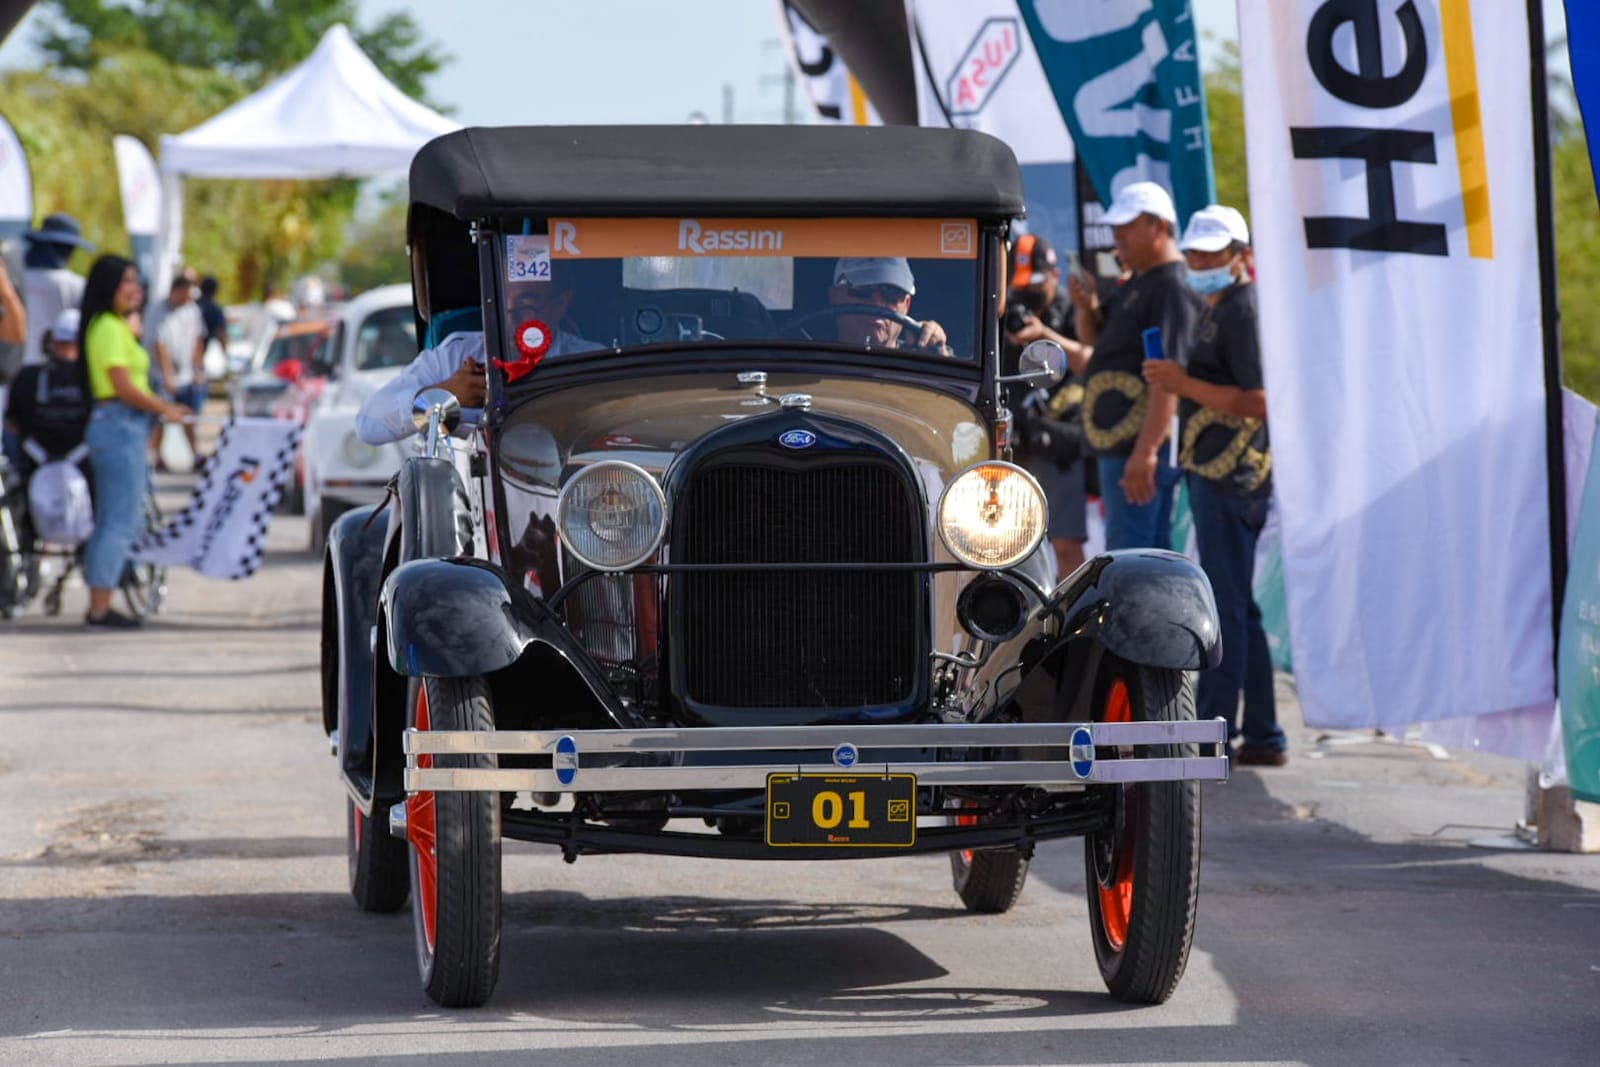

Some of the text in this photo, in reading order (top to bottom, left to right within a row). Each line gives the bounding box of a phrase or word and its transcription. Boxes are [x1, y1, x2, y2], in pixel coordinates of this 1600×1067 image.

[552, 221, 581, 256] R
[678, 218, 784, 254] Rassini
[516, 260, 549, 277] 342
[812, 790, 870, 829] 01
